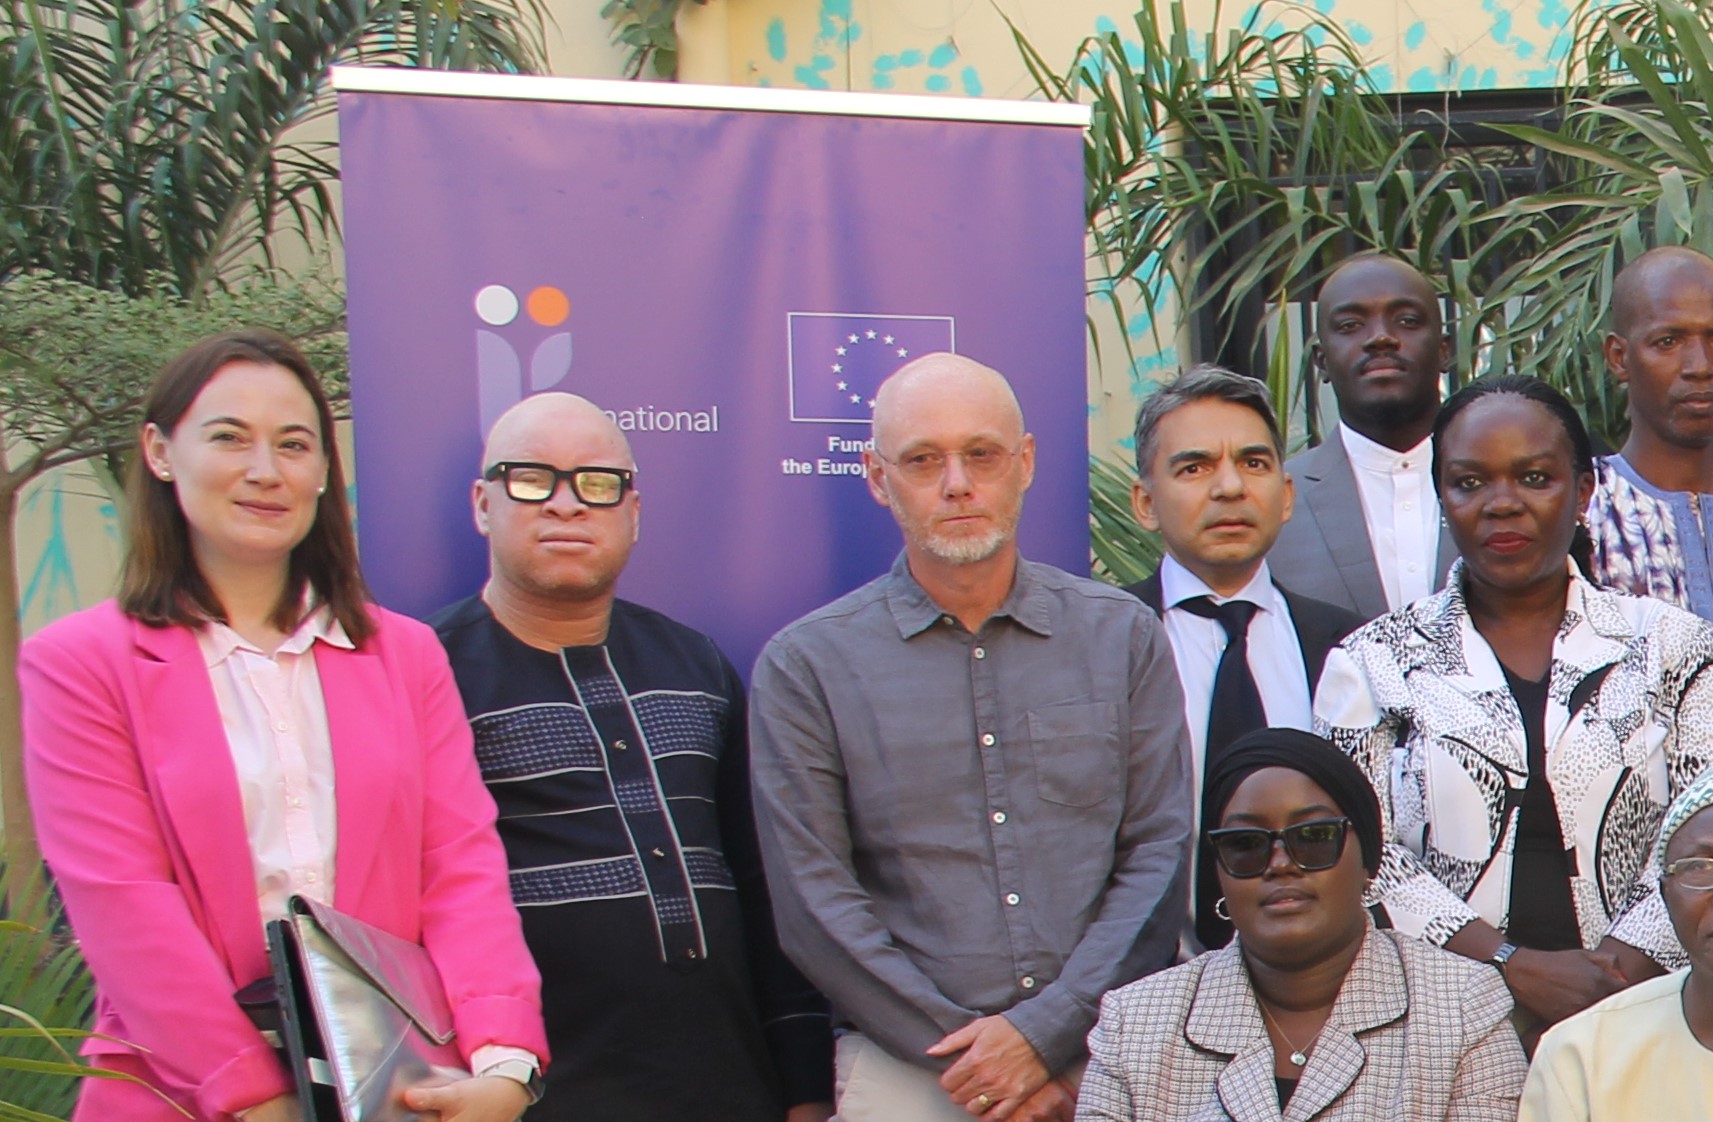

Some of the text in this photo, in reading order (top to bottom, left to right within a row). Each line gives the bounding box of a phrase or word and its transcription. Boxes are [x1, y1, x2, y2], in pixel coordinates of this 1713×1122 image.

[603, 405, 719, 432] national
[828, 436, 875, 452] Fund
[782, 458, 867, 479] the Euro
